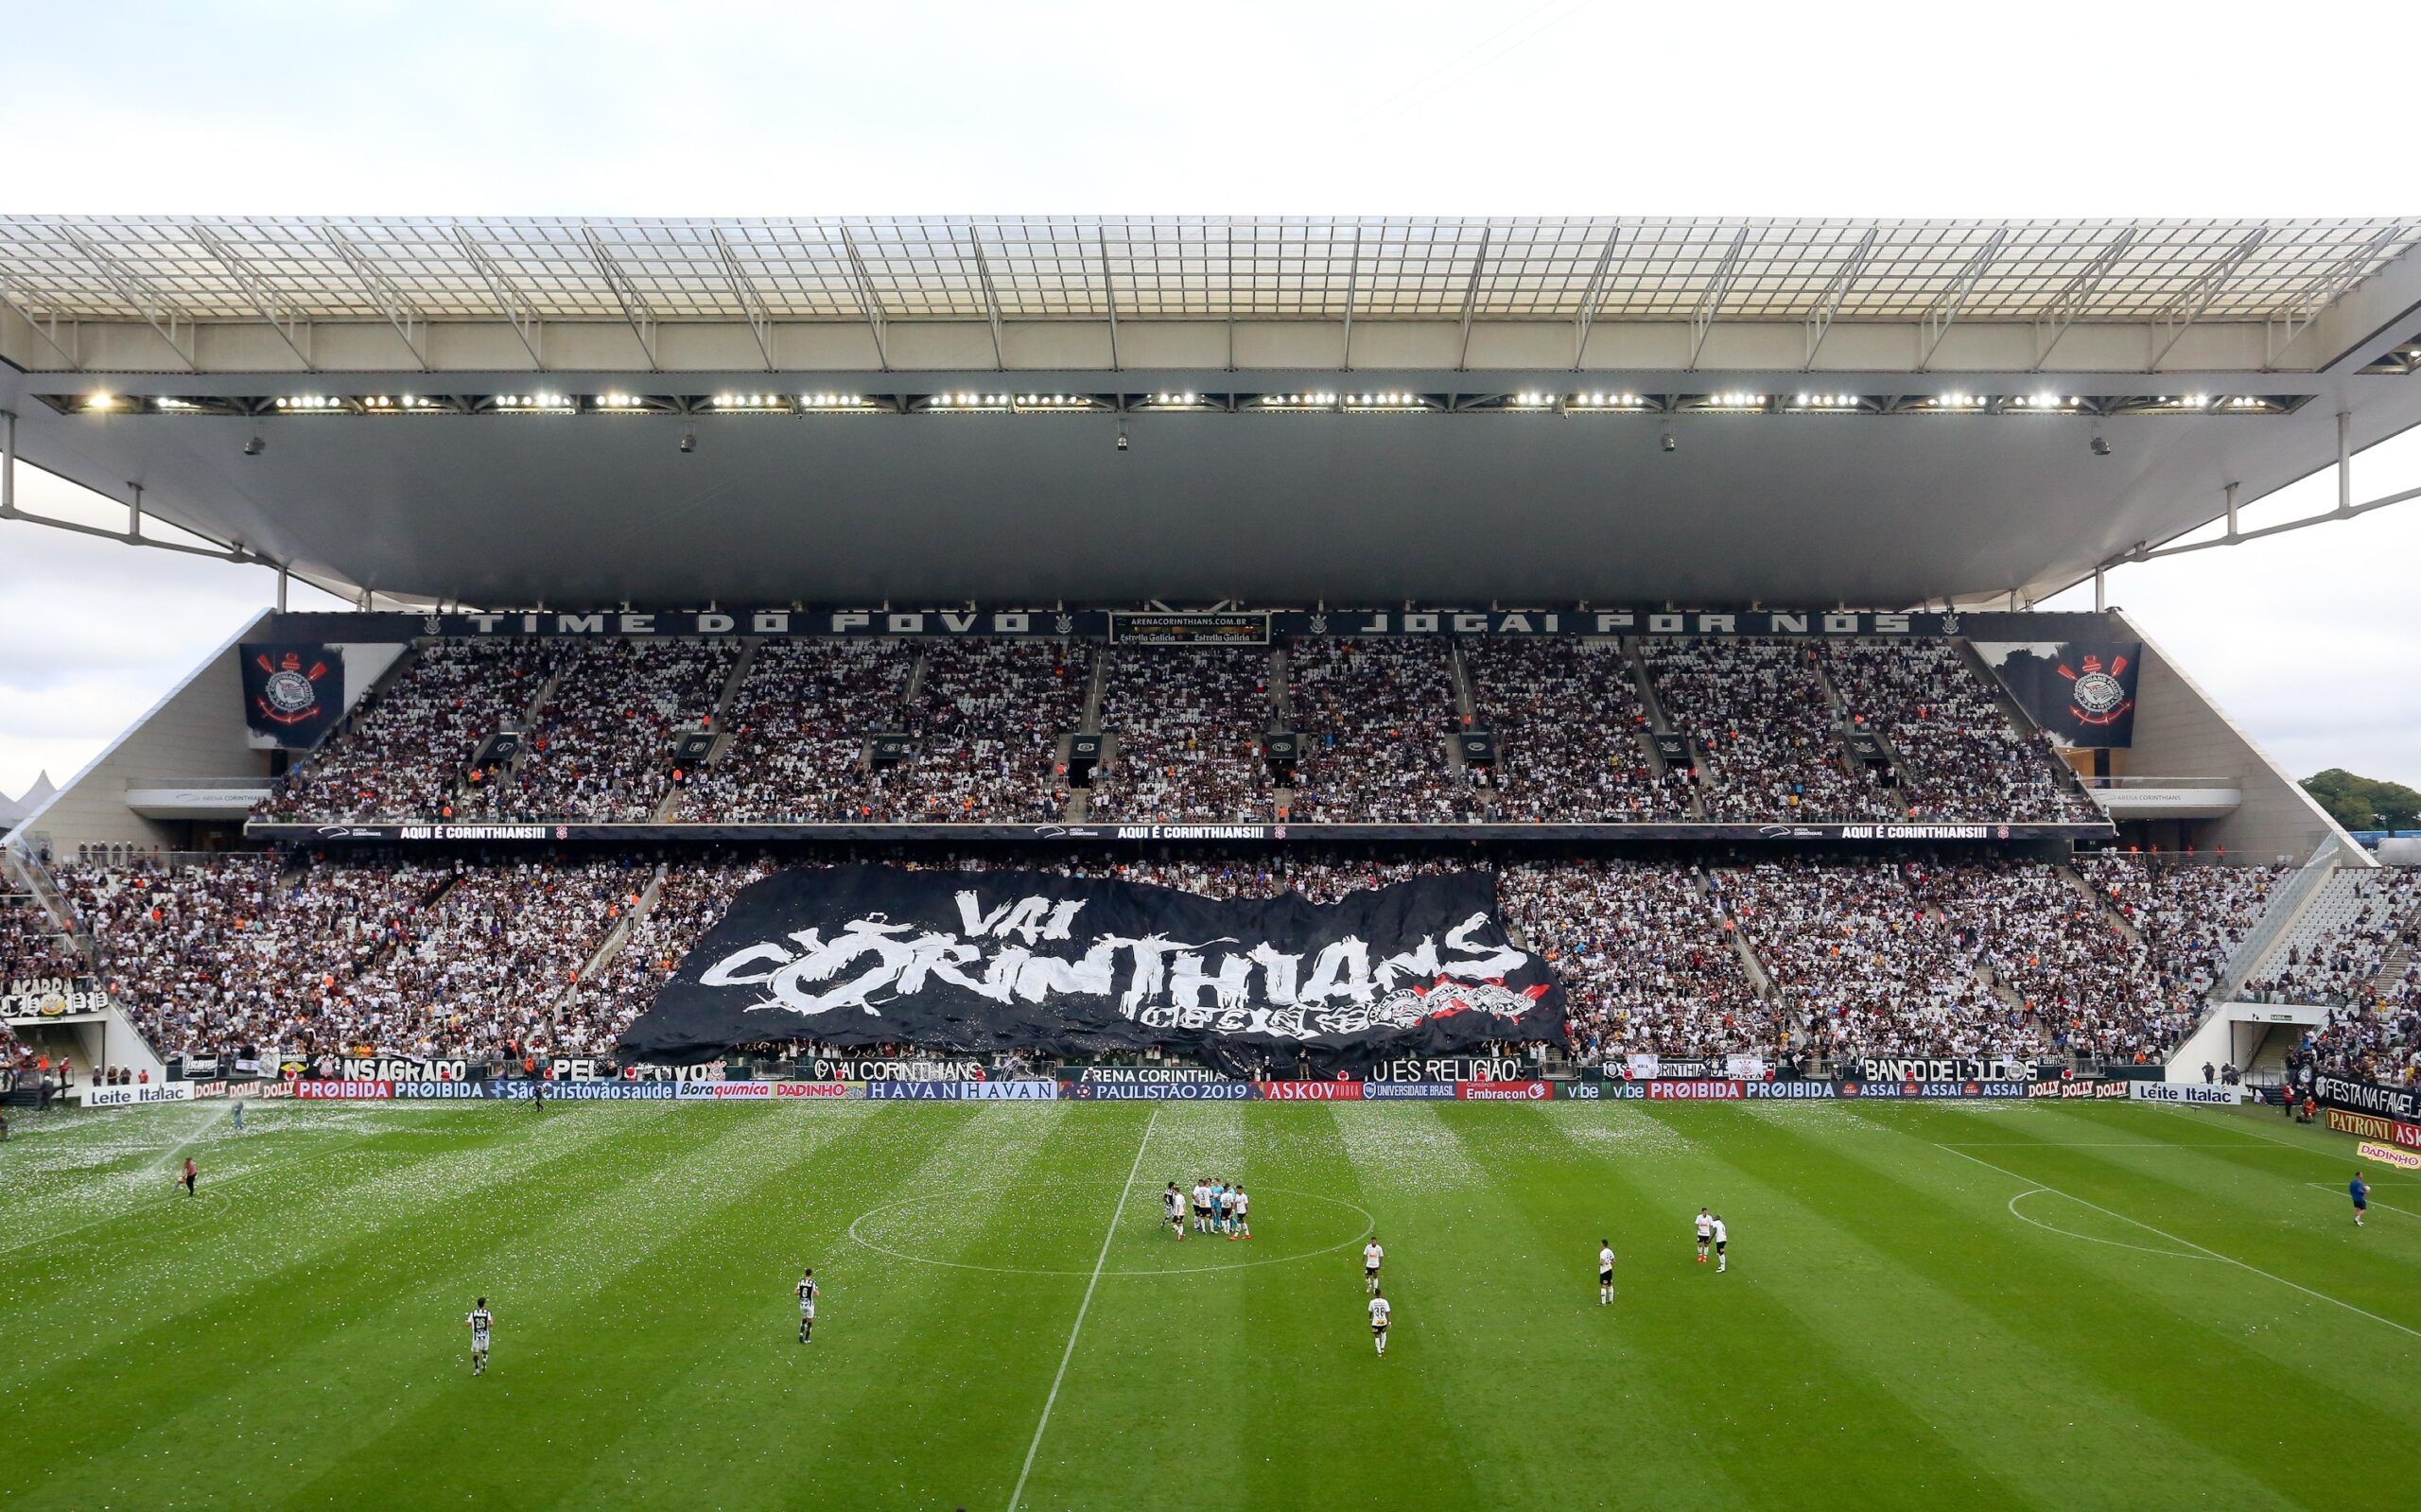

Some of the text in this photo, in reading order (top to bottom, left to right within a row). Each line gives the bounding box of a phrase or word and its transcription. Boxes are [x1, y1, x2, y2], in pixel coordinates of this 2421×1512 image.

[469, 614, 1029, 633] TIME DO POVO
[1130, 617, 1247, 626] ARENACORINTHIANS.COM.BR
[1597, 614, 1736, 633] POR
[1120, 633, 1176, 642] Estrella Galicia
[1193, 633, 1250, 642] Estrella Galicia
[401, 826, 431, 840] AQUI
[434, 825, 443, 839] É
[1118, 826, 1148, 840] AQUI
[1152, 825, 1160, 839] É
[1841, 826, 1872, 840] AQUI
[1875, 825, 1884, 839] É
[954, 889, 1089, 946] VAI
[699, 911, 1528, 1019] CORINTHIANS
[1081, 1069, 1136, 1082] ARENA
[1865, 1060, 1926, 1082] BANDO
[1928, 1060, 1953, 1082] DE
[91, 1086, 184, 1105] Leite Italac
[195, 1081, 228, 1098] DOLLY
[229, 1081, 261, 1098] DOLLY
[263, 1081, 296, 1099] DOLLY
[507, 1082, 672, 1099] São Cristóvão saúde
[680, 1082, 769, 1099] Boraquímica
[775, 1083, 845, 1097] DADINHO
[870, 1083, 957, 1099] HAVAN
[967, 1082, 1053, 1099] HAVAN
[1097, 1080, 1246, 1099] PAULISTÃO 2019
[1269, 1083, 1335, 1099] ASKOV
[1377, 1085, 1455, 1097] UNIVERSIDADE BRASIL
[1466, 1088, 1526, 1099] Embracon
[2029, 1081, 2060, 1098] DOLLY
[2062, 1081, 2094, 1098] DOLLY
[2096, 1081, 2128, 1098] DOLLY
[2140, 1085, 2232, 1103] Leite Italac
[2325, 1078, 2361, 1105] FESTA
[2329, 1111, 2390, 1141] PATRONI
[2360, 1145, 2419, 1167] DADINHO
